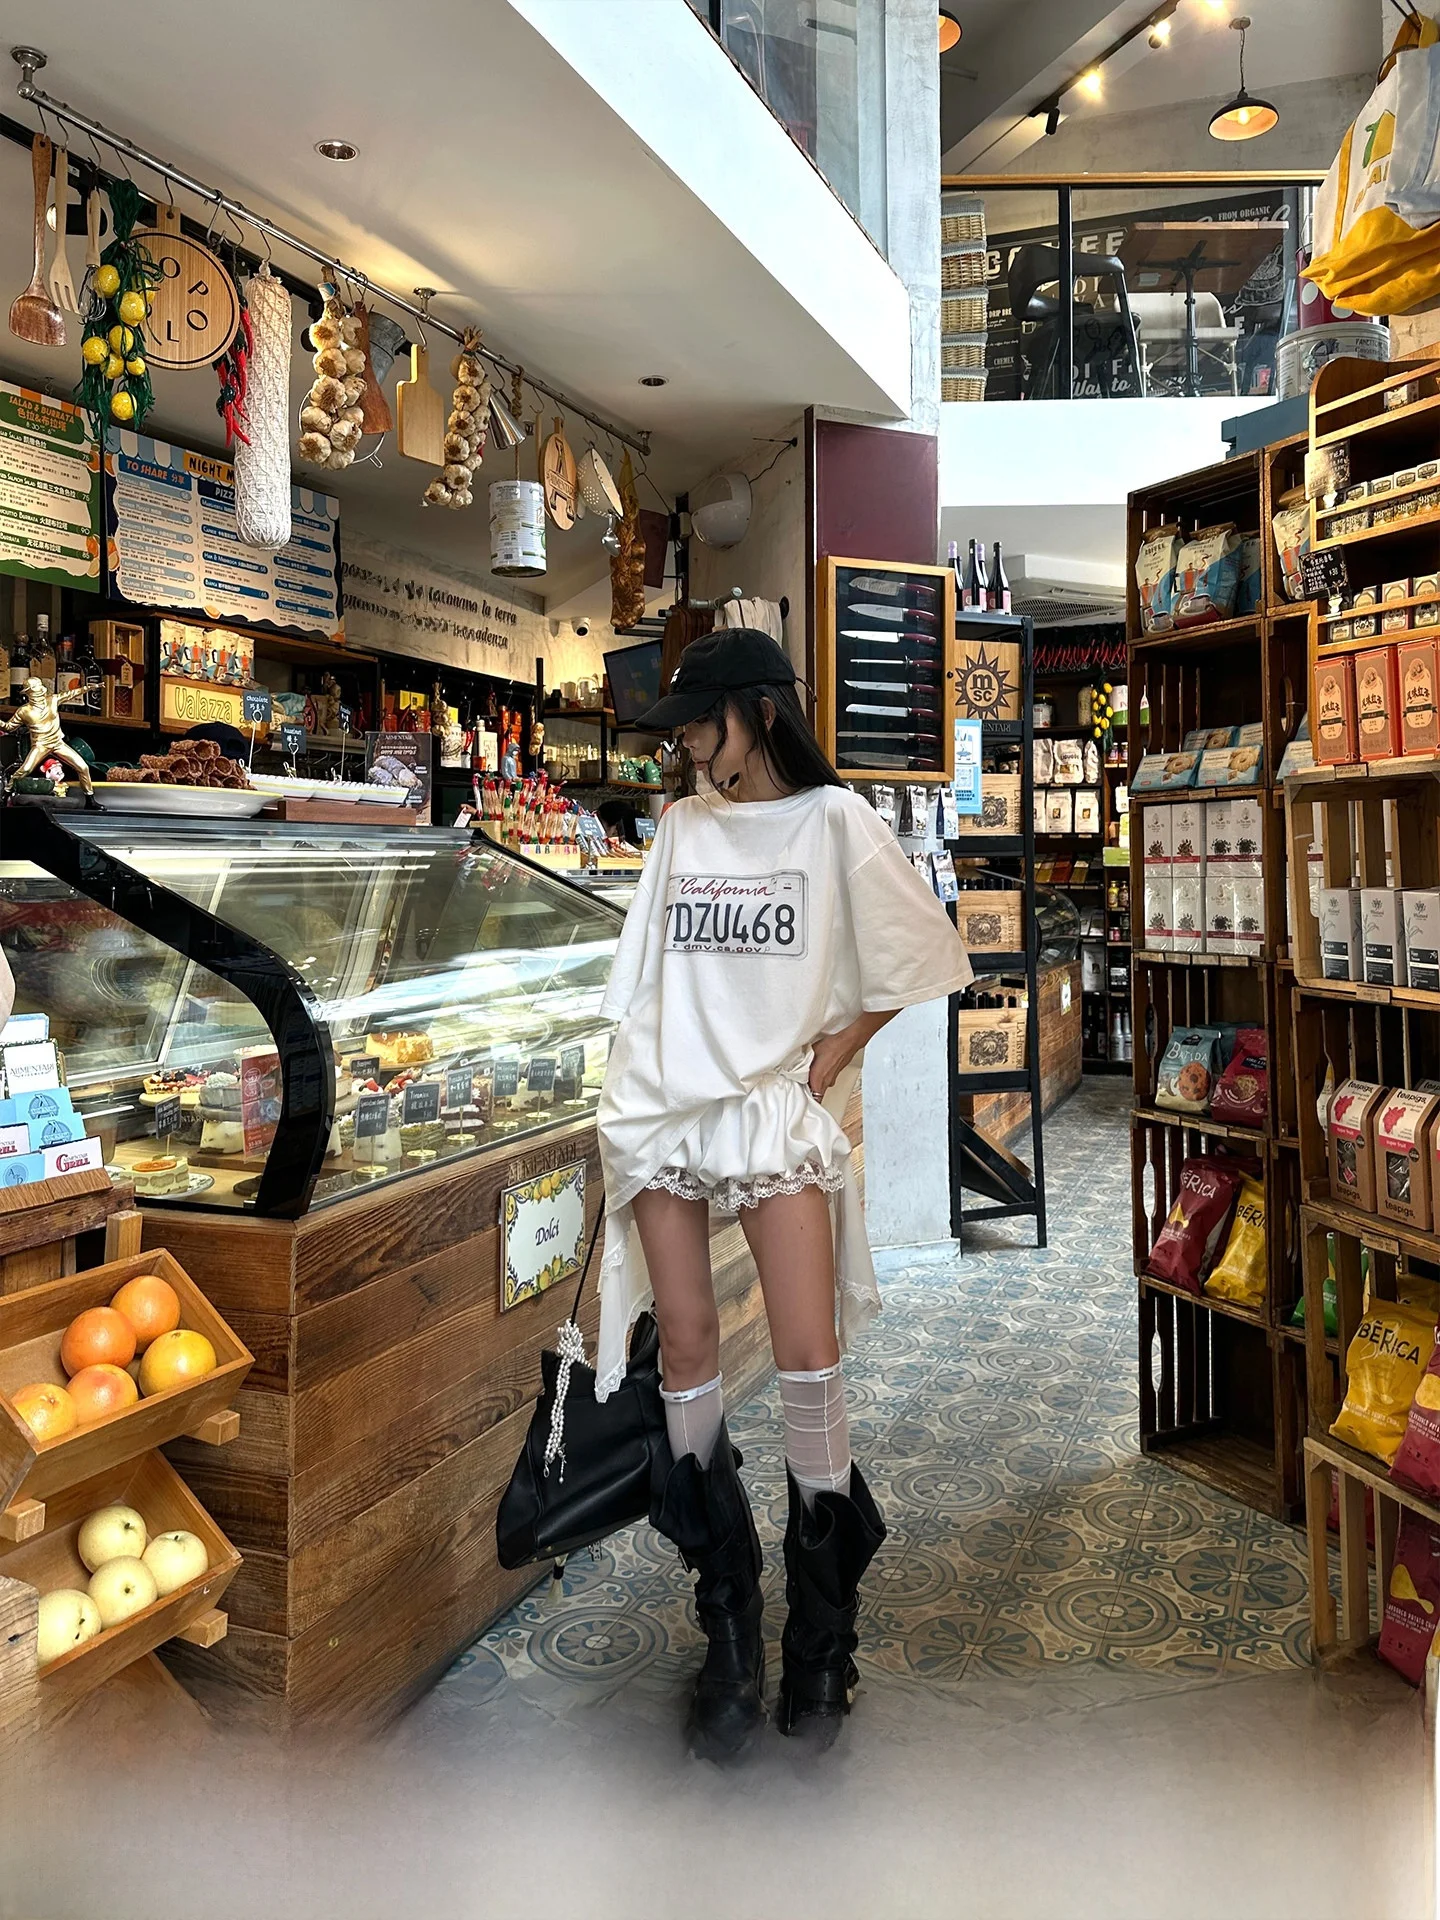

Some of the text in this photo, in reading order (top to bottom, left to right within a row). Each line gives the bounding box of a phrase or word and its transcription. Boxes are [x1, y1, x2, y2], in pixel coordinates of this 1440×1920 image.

[1218, 211, 1238, 220] FROM
[1240, 205, 1270, 218] ORGANIC
[1112, 377, 1131, 392] to
[9, 395, 75, 424] SALAD & BURRATA
[126, 460, 138, 470] TO
[140, 464, 168, 480] SHARE
[189, 457, 222, 479] NIGHT
[215, 487, 235, 499] PIZZ
[80, 527, 90, 535] 90
[494, 606, 517, 626] terra
[174, 686, 233, 724] Valazza
[680, 877, 775, 902] California
[683, 943, 762, 953] dmv.ca.gov
[535, 1217, 560, 1246] Dolci
